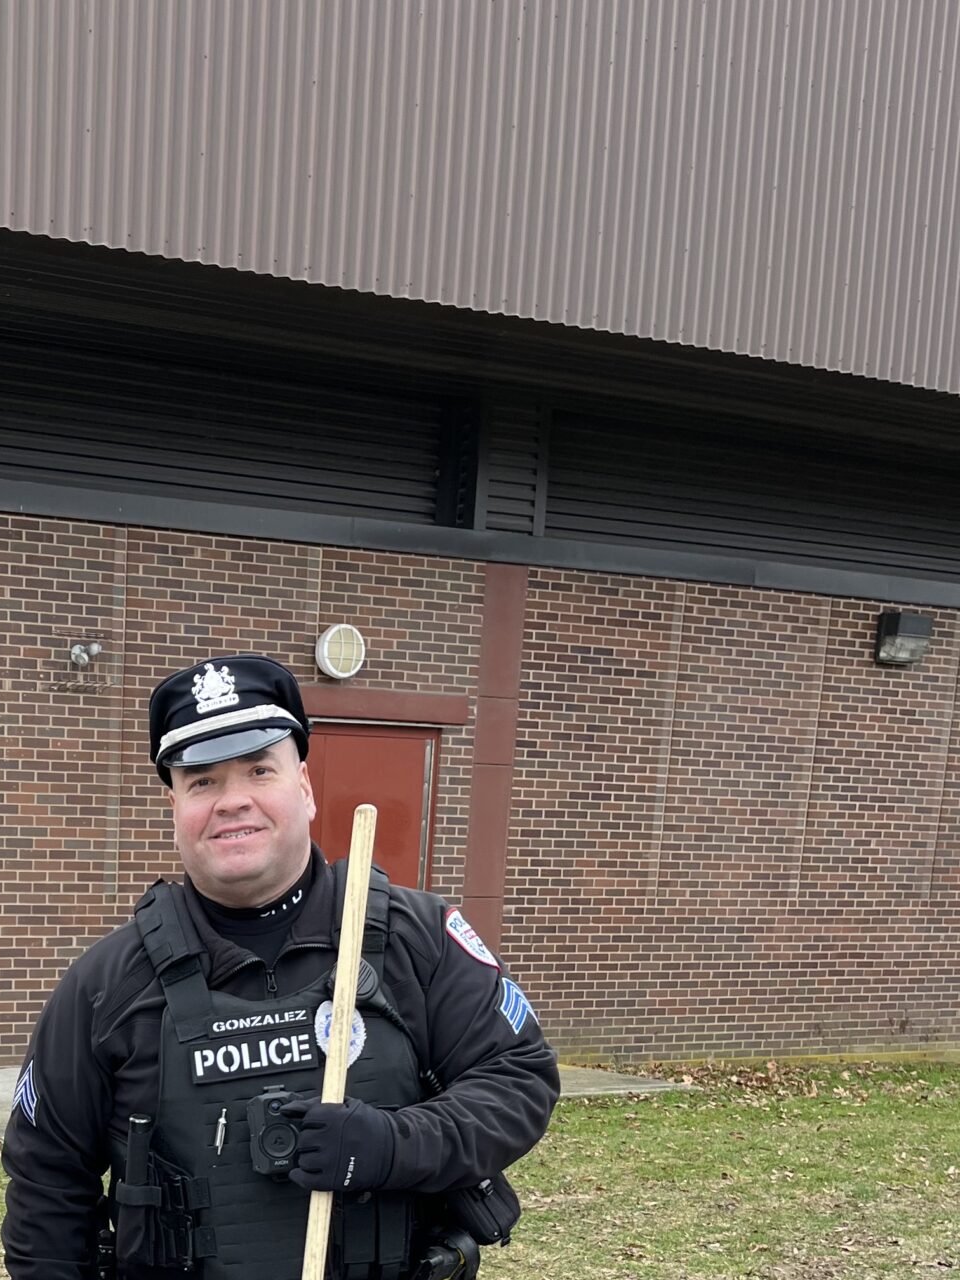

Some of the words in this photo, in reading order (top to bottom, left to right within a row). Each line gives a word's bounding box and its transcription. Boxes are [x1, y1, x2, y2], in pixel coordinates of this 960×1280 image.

[212, 1009, 307, 1033] GONZALEZ
[194, 1034, 313, 1077] POLICE
[343, 1156, 356, 1187] HEAD
